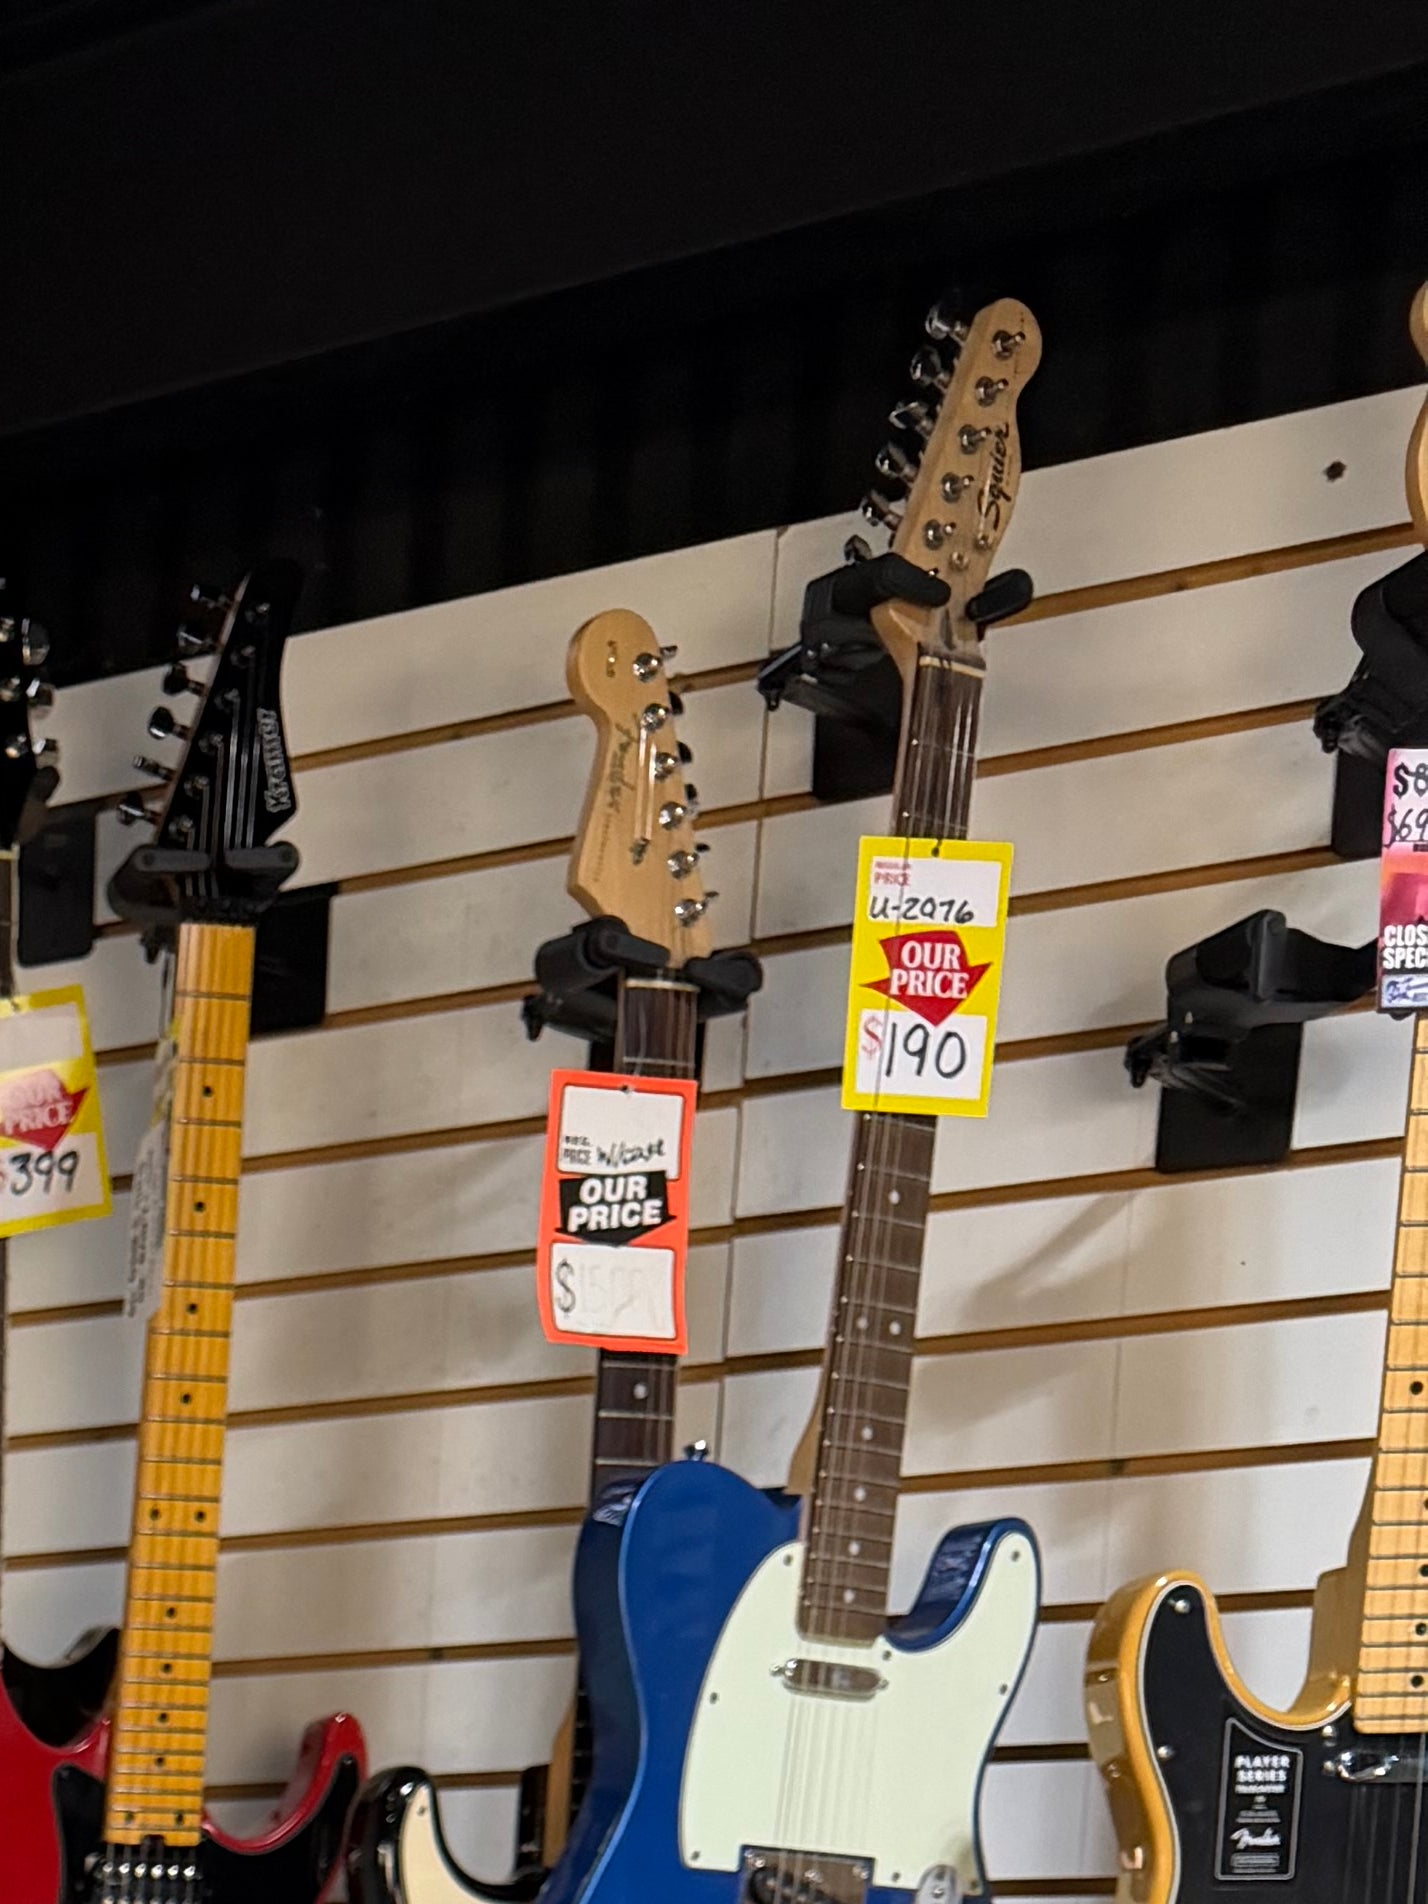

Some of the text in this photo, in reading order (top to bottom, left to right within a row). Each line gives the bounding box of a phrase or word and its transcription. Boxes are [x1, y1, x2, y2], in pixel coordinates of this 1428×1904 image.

[977, 423, 1011, 532] Squier
[874, 872, 911, 886] PRICE
[901, 940, 961, 970] OUR
[890, 968, 970, 999] PRICE
[579, 1175, 648, 1204] OUR
[567, 1199, 664, 1233] PRICE
[1234, 1755, 1290, 1768] PLAYER
[1236, 1769, 1287, 1782] SERIES
